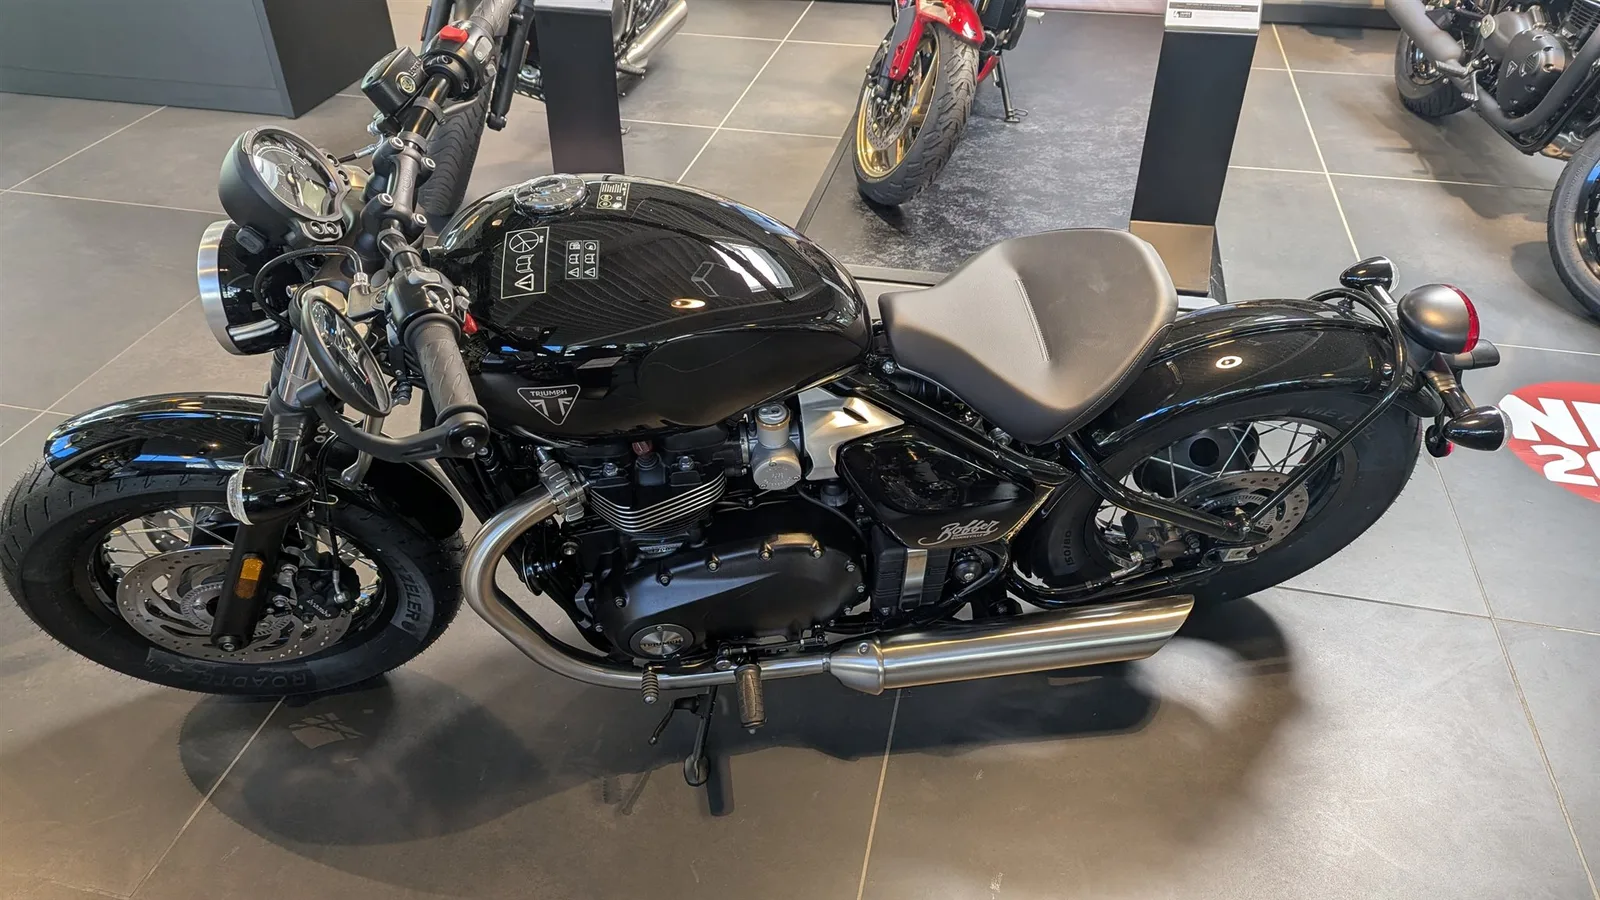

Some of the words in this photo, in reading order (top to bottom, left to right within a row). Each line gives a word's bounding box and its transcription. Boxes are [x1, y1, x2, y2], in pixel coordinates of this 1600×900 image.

[530, 389, 568, 397] TRIUMPH
[1498, 393, 1600, 449] N
[1530, 444, 1600, 487] 2
[918, 519, 1000, 546] Bobber
